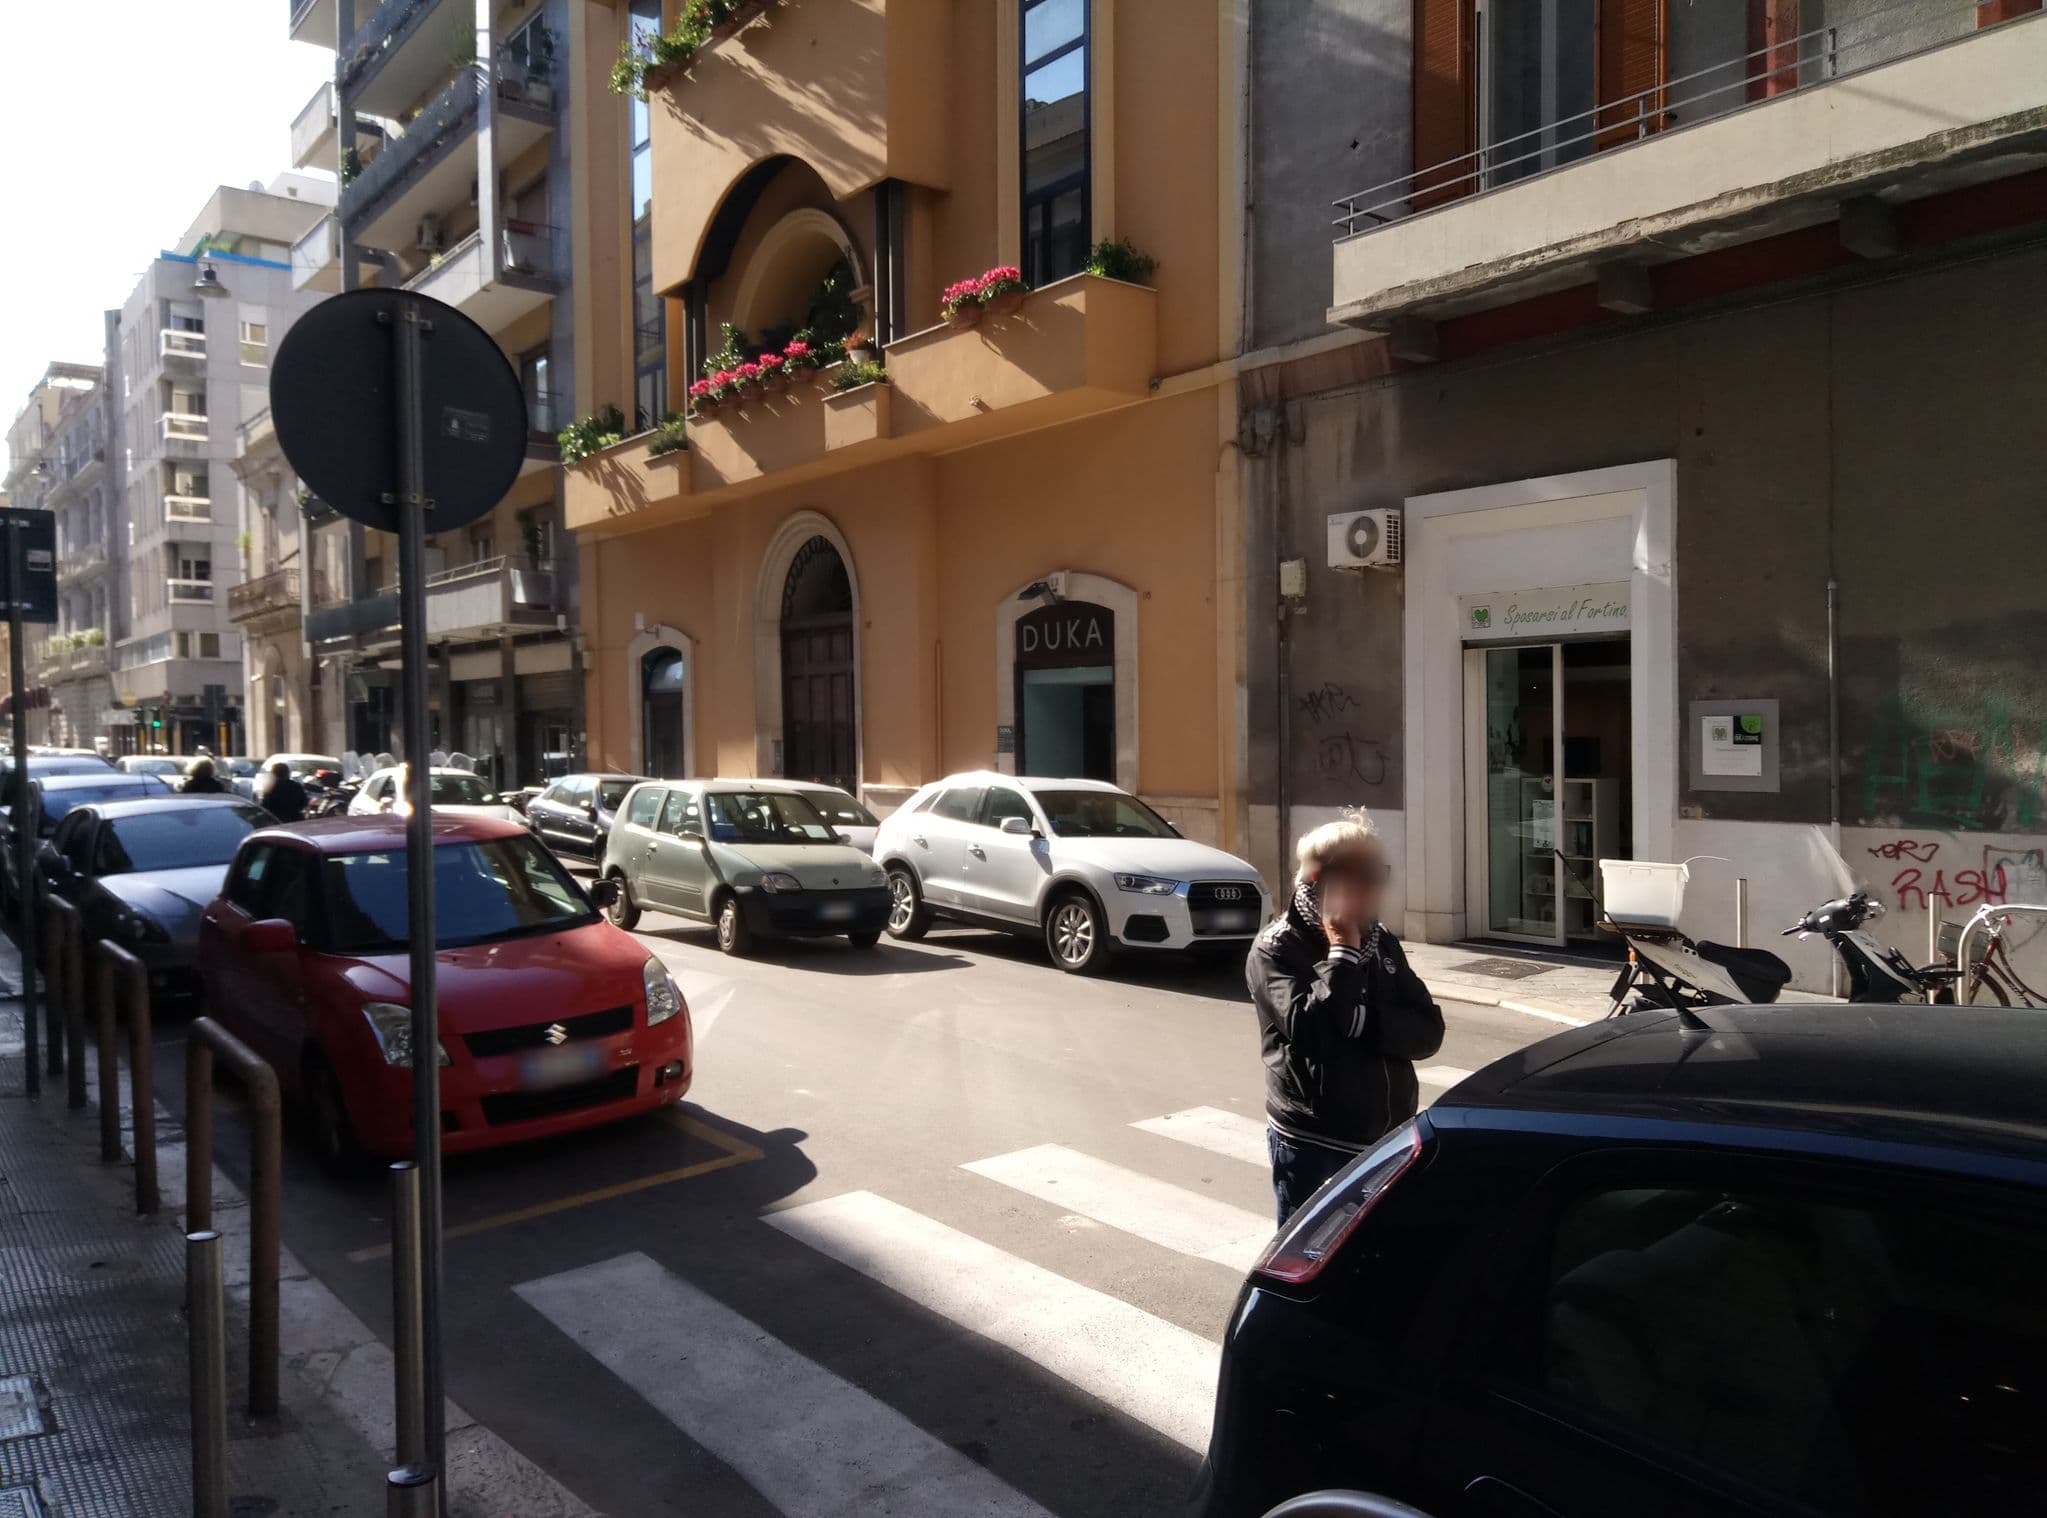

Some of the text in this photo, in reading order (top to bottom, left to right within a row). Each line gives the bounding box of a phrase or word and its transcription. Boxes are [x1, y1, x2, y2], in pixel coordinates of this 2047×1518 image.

[1503, 604, 1559, 631] Sposarsi
[1560, 600, 1578, 621] al
[1022, 617, 1104, 652] DUKA
[1891, 863, 2011, 920] RASH
